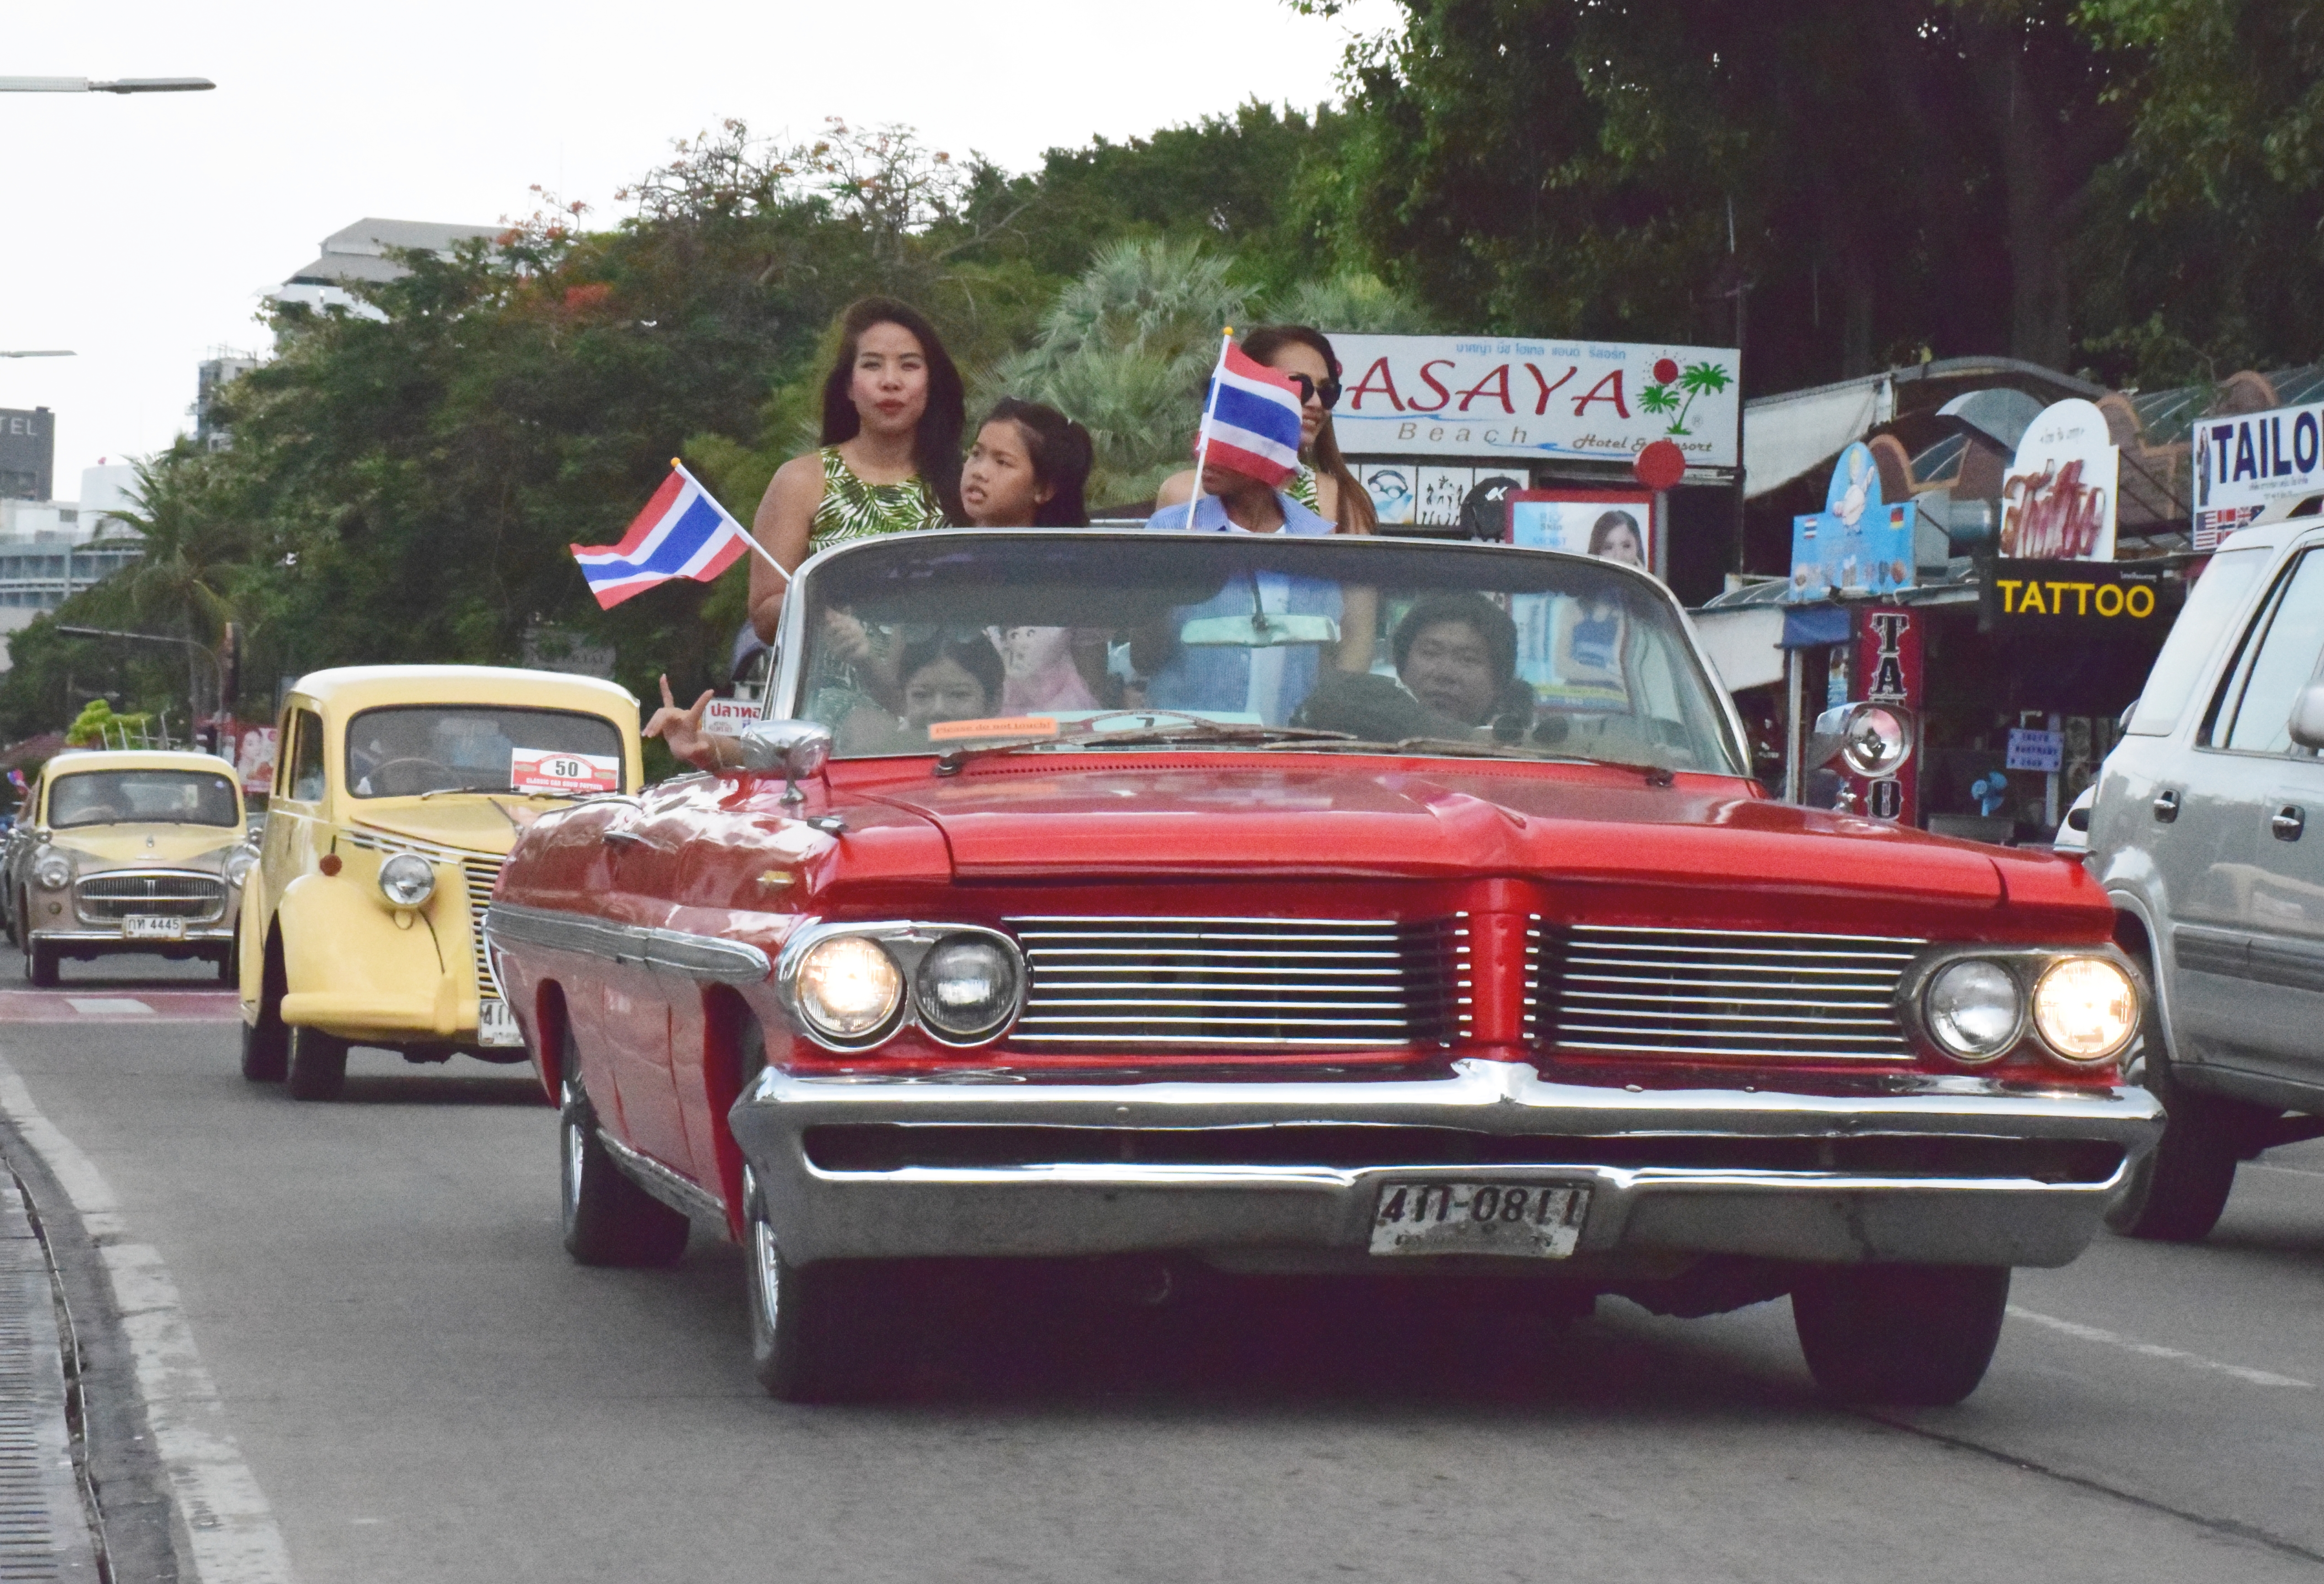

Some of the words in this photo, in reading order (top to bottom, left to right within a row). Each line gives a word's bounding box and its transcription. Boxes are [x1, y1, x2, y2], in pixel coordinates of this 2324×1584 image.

[1336, 356, 1631, 419] ASAYA
[1398, 422, 1527, 444] Beach
[1572, 433, 1628, 449] Hotel
[1662, 437, 1713, 452] sort
[2212, 409, 2324, 484] TAILO
[1996, 579, 2155, 618] TATTOO
[935, 725, 973, 734] Please
[555, 760, 578, 777] 50
[579, 782, 603, 791] PATTAYA
[150, 919, 179, 930] 4445
